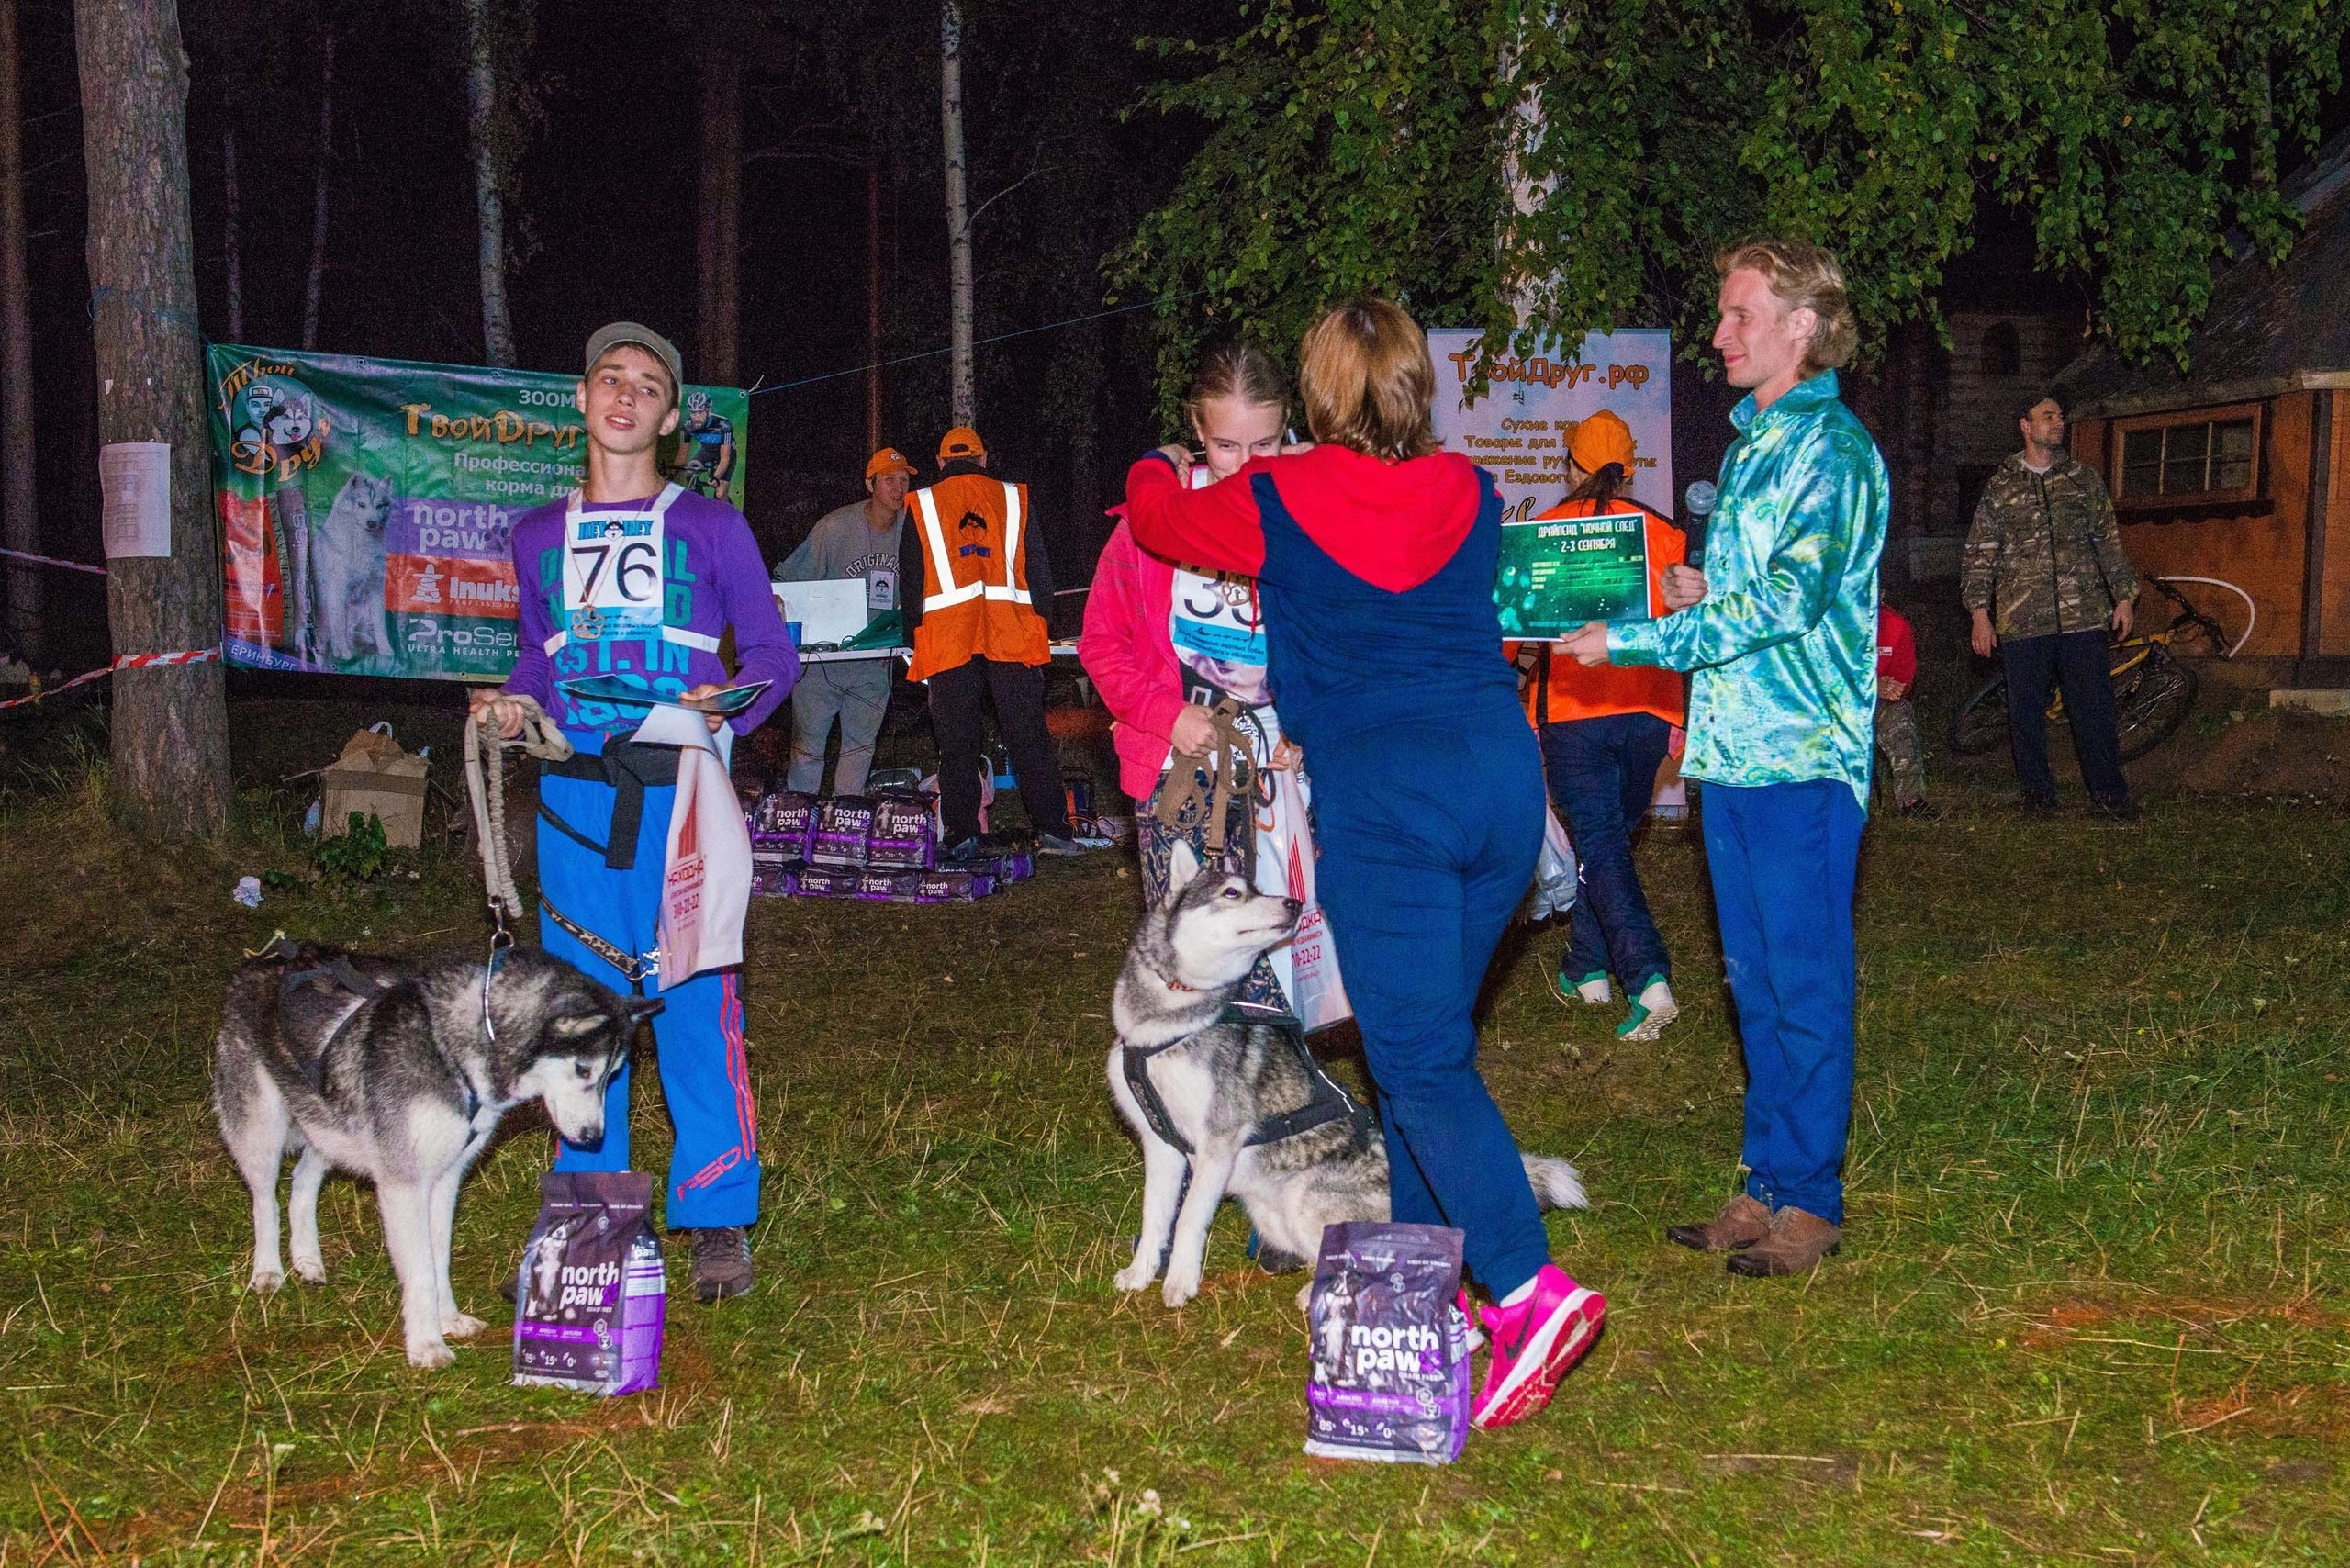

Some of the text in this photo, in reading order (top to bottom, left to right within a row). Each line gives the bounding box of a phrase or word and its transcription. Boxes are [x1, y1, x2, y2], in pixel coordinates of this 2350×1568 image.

[1448, 353, 1650, 390] ТойДруг.рф
[1501, 417, 1548, 432] Сухие
[1464, 435, 1522, 451] Товары
[1528, 438, 1556, 450] для
[1470, 454, 1537, 466] ряжение
[486, 479, 544, 496] корма
[413, 503, 509, 530] north
[1538, 524, 1578, 539] ДРАЙЛЕНД
[420, 527, 487, 553] paw
[1561, 537, 1617, 553] 2-3 СЕНТЯБРЯ
[572, 543, 657, 602] 76
[449, 599, 520, 609] PROFESSIONA
[408, 644, 446, 654] ULTRA
[453, 647, 499, 656] HEALTH
[776, 807, 808, 818] north
[834, 808, 871, 819] north
[891, 813, 927, 824] north
[777, 816, 800, 828] paw
[835, 816, 862, 827] paw
[893, 823, 918, 834] paw
[561, 1261, 620, 1286] north
[559, 1284, 604, 1310] paw
[1350, 1324, 1439, 1351] north
[1356, 1348, 1421, 1375] paw
